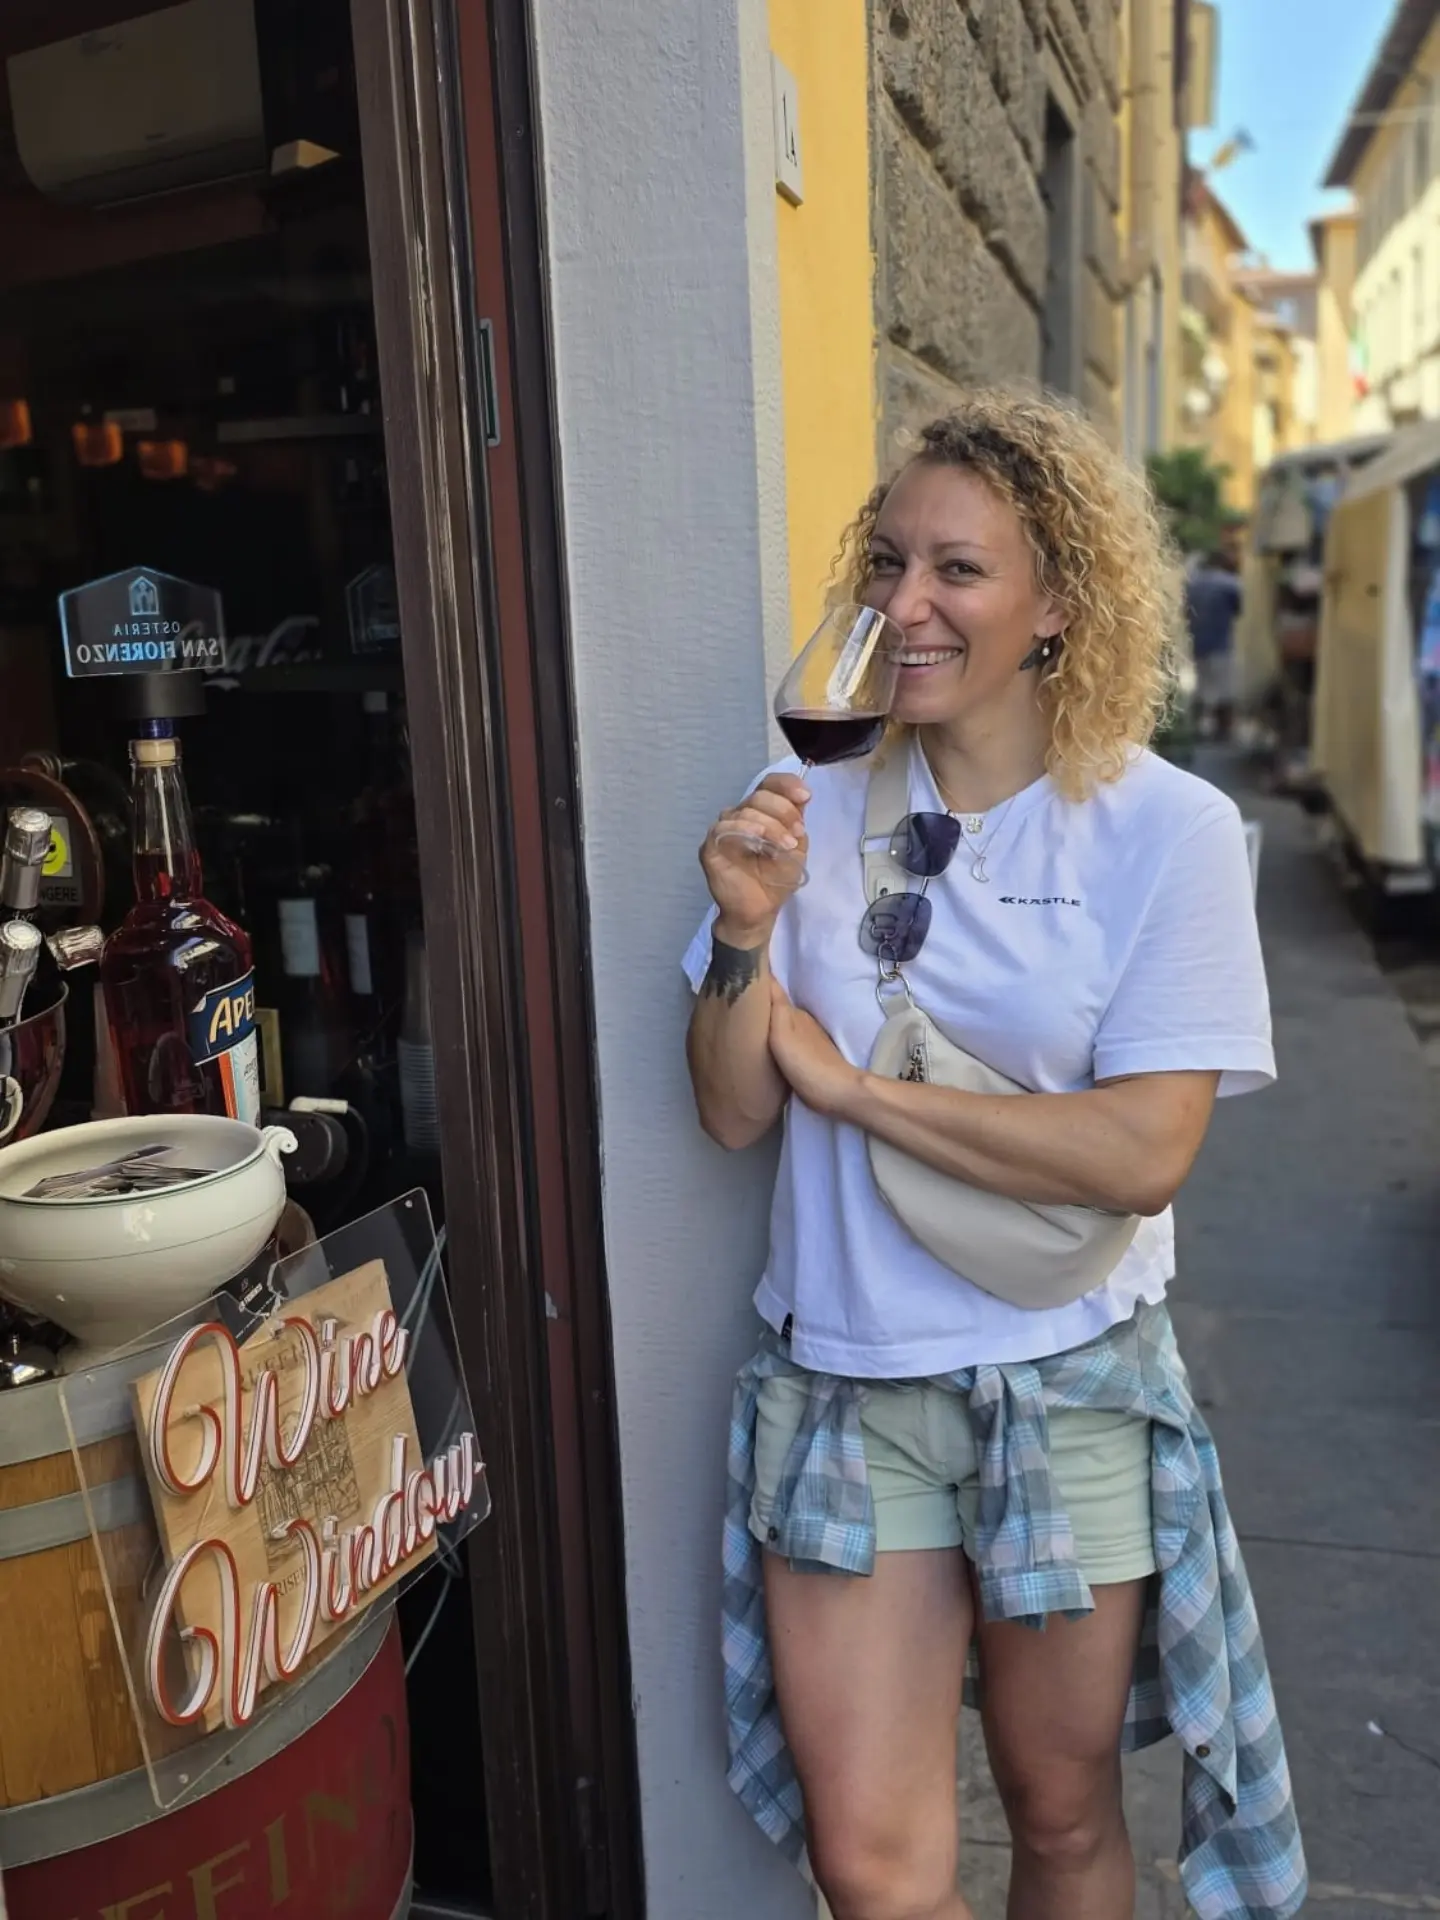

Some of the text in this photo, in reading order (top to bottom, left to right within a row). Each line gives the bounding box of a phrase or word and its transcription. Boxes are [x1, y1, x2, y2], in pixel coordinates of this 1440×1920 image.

[210, 984, 255, 1043] APE
[149, 1309, 408, 1507] Wine
[145, 1433, 485, 1728] Window
